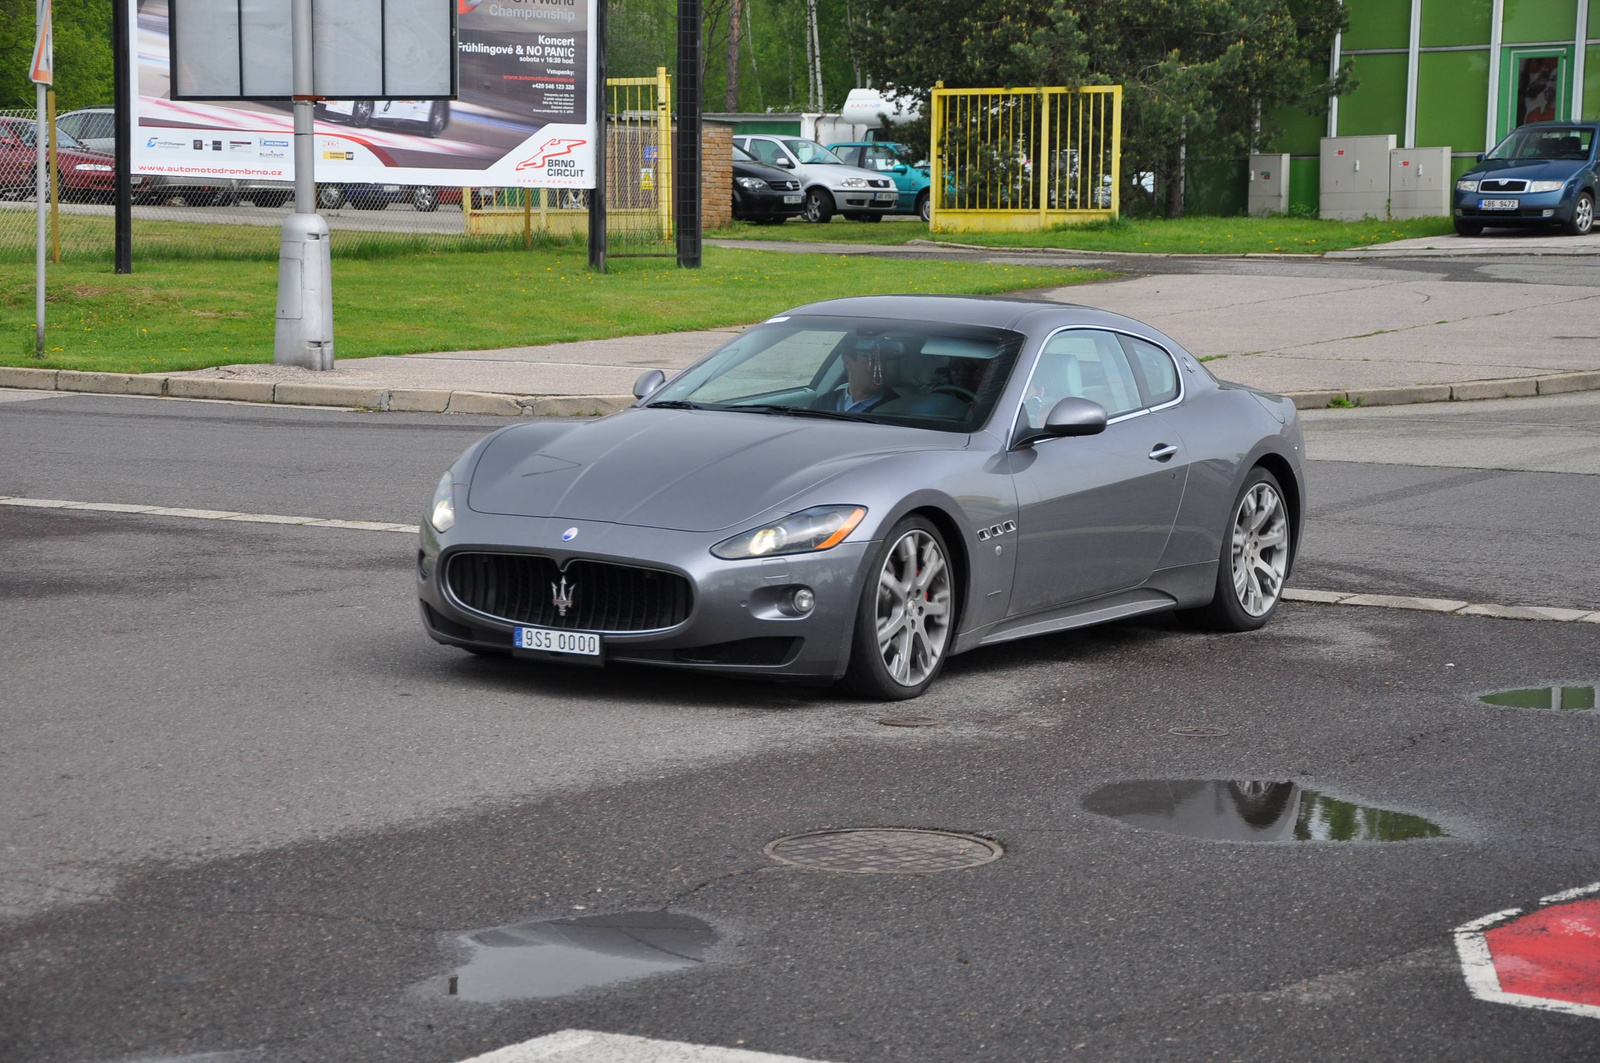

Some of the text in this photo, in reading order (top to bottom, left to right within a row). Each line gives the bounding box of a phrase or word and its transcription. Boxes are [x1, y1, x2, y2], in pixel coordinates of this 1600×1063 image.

[489, 4, 575, 22] Championship
[538, 35, 575, 46] Koncert
[458, 42, 575, 58] Frühlingové & NO PAN!C
[546, 68, 575, 76] Vstupenky:
[547, 159, 575, 168] BRNO
[138, 165, 283, 176] www.automotodrombrno.cz
[547, 168, 585, 177] CIRCUIT
[526, 630, 596, 652] 9S5 0000
